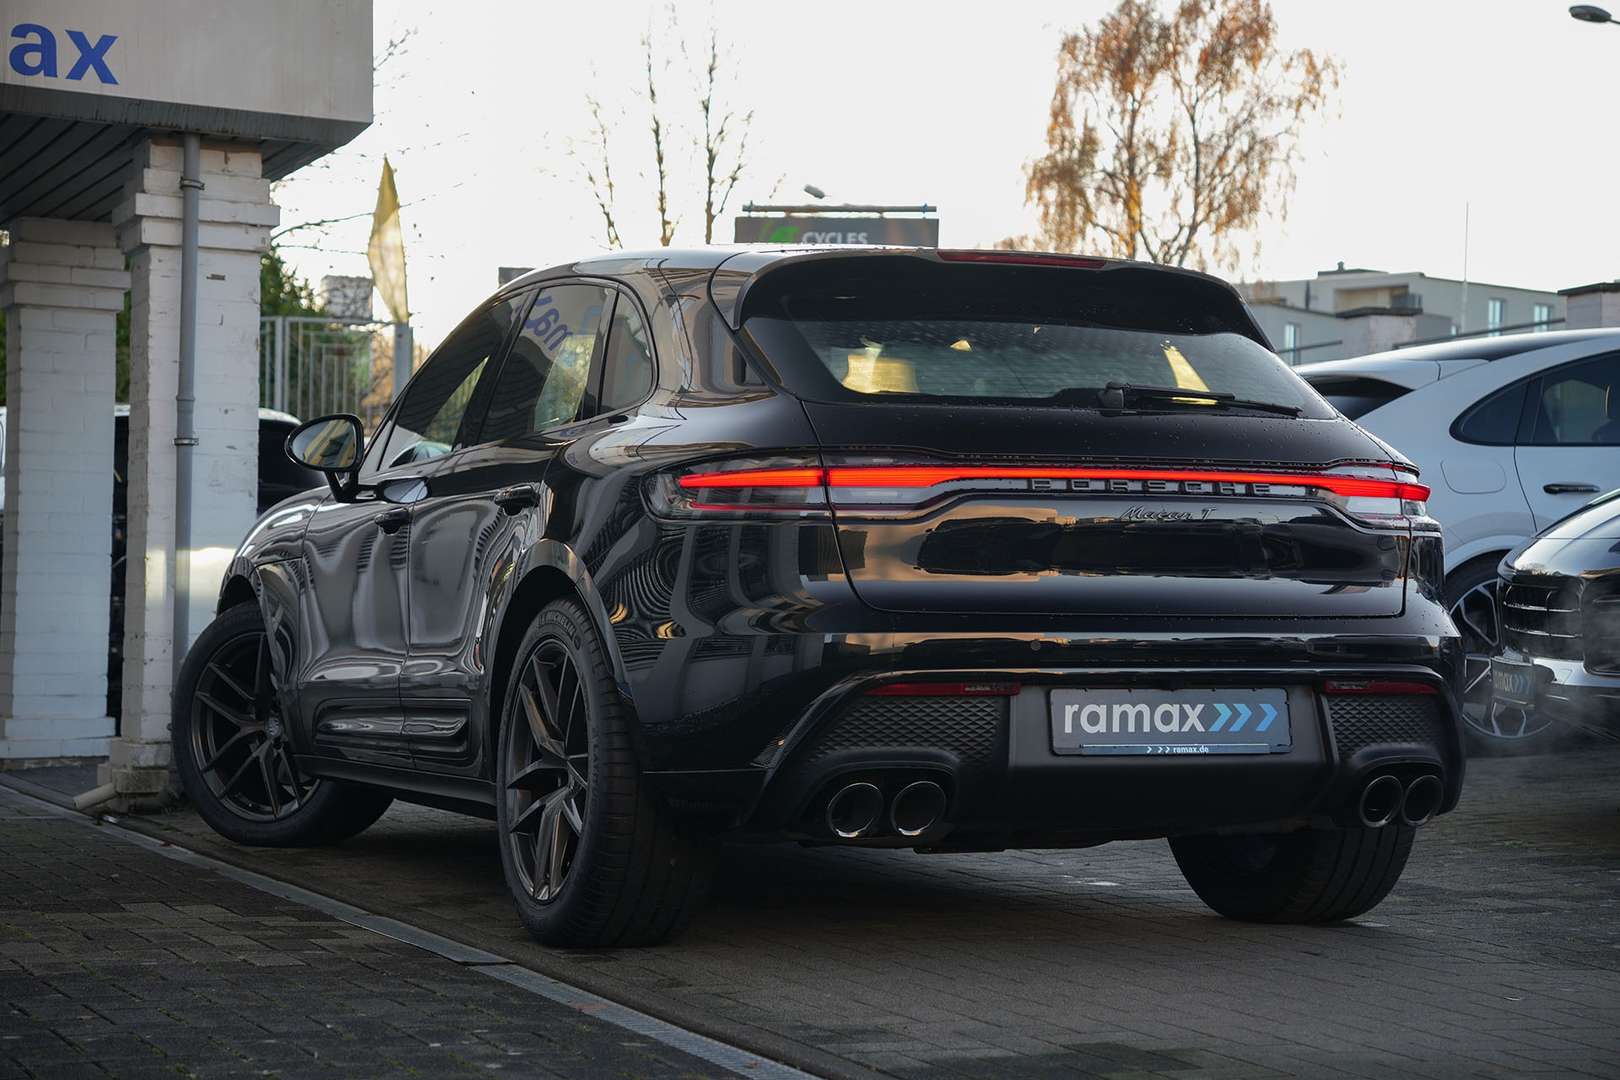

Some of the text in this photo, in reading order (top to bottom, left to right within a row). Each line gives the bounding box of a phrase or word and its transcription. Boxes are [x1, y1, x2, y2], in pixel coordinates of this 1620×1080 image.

[9, 23, 119, 85] ax
[802, 231, 868, 244] CYCLES
[1031, 479, 1271, 496] PORSCHE
[1120, 504, 1217, 520] Macan T
[1064, 703, 1206, 733] ramax
[1173, 745, 1209, 753] ramax.de
